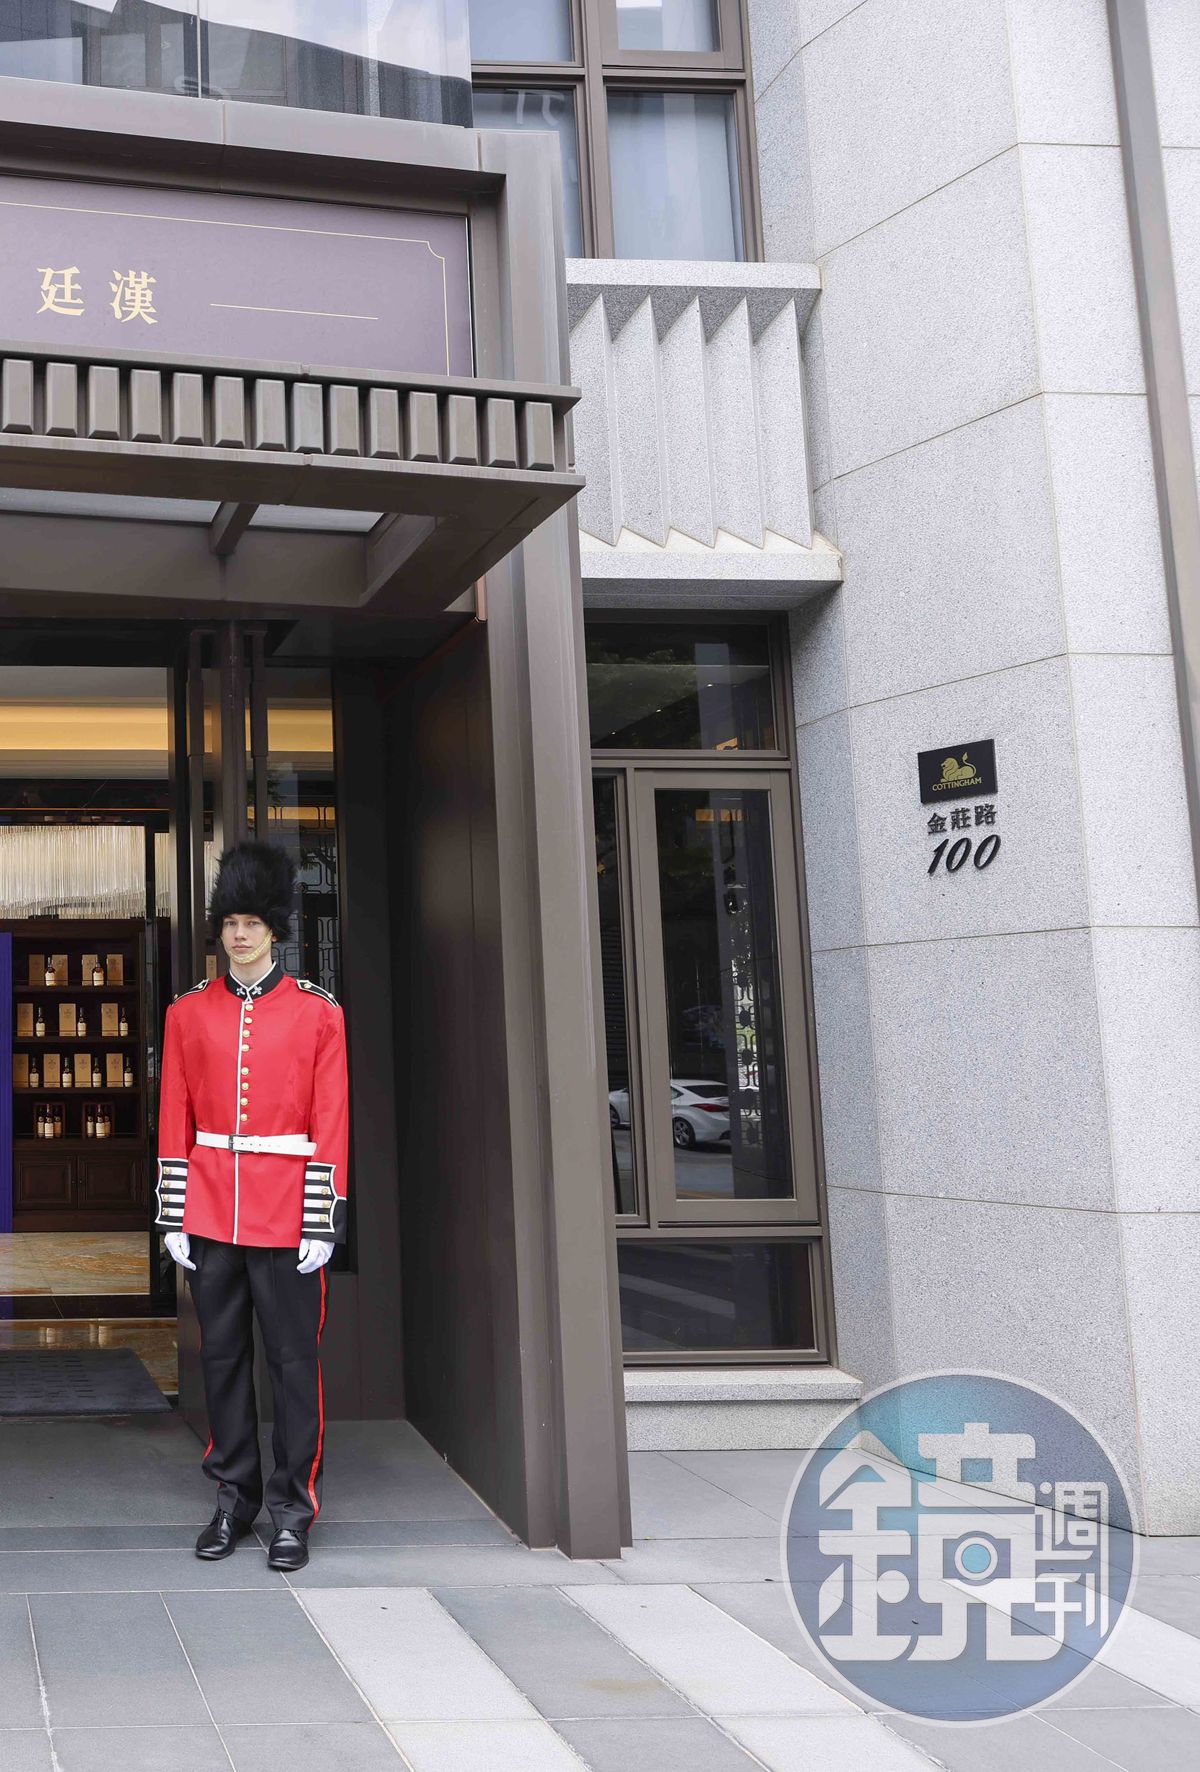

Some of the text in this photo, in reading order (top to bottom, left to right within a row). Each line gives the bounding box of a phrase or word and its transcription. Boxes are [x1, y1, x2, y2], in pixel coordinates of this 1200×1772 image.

[36, 266, 158, 325] 廷漢
[932, 776, 982, 792] COTTINGHAM
[927, 804, 997, 835] 金莊路
[927, 834, 1001, 875] 100
